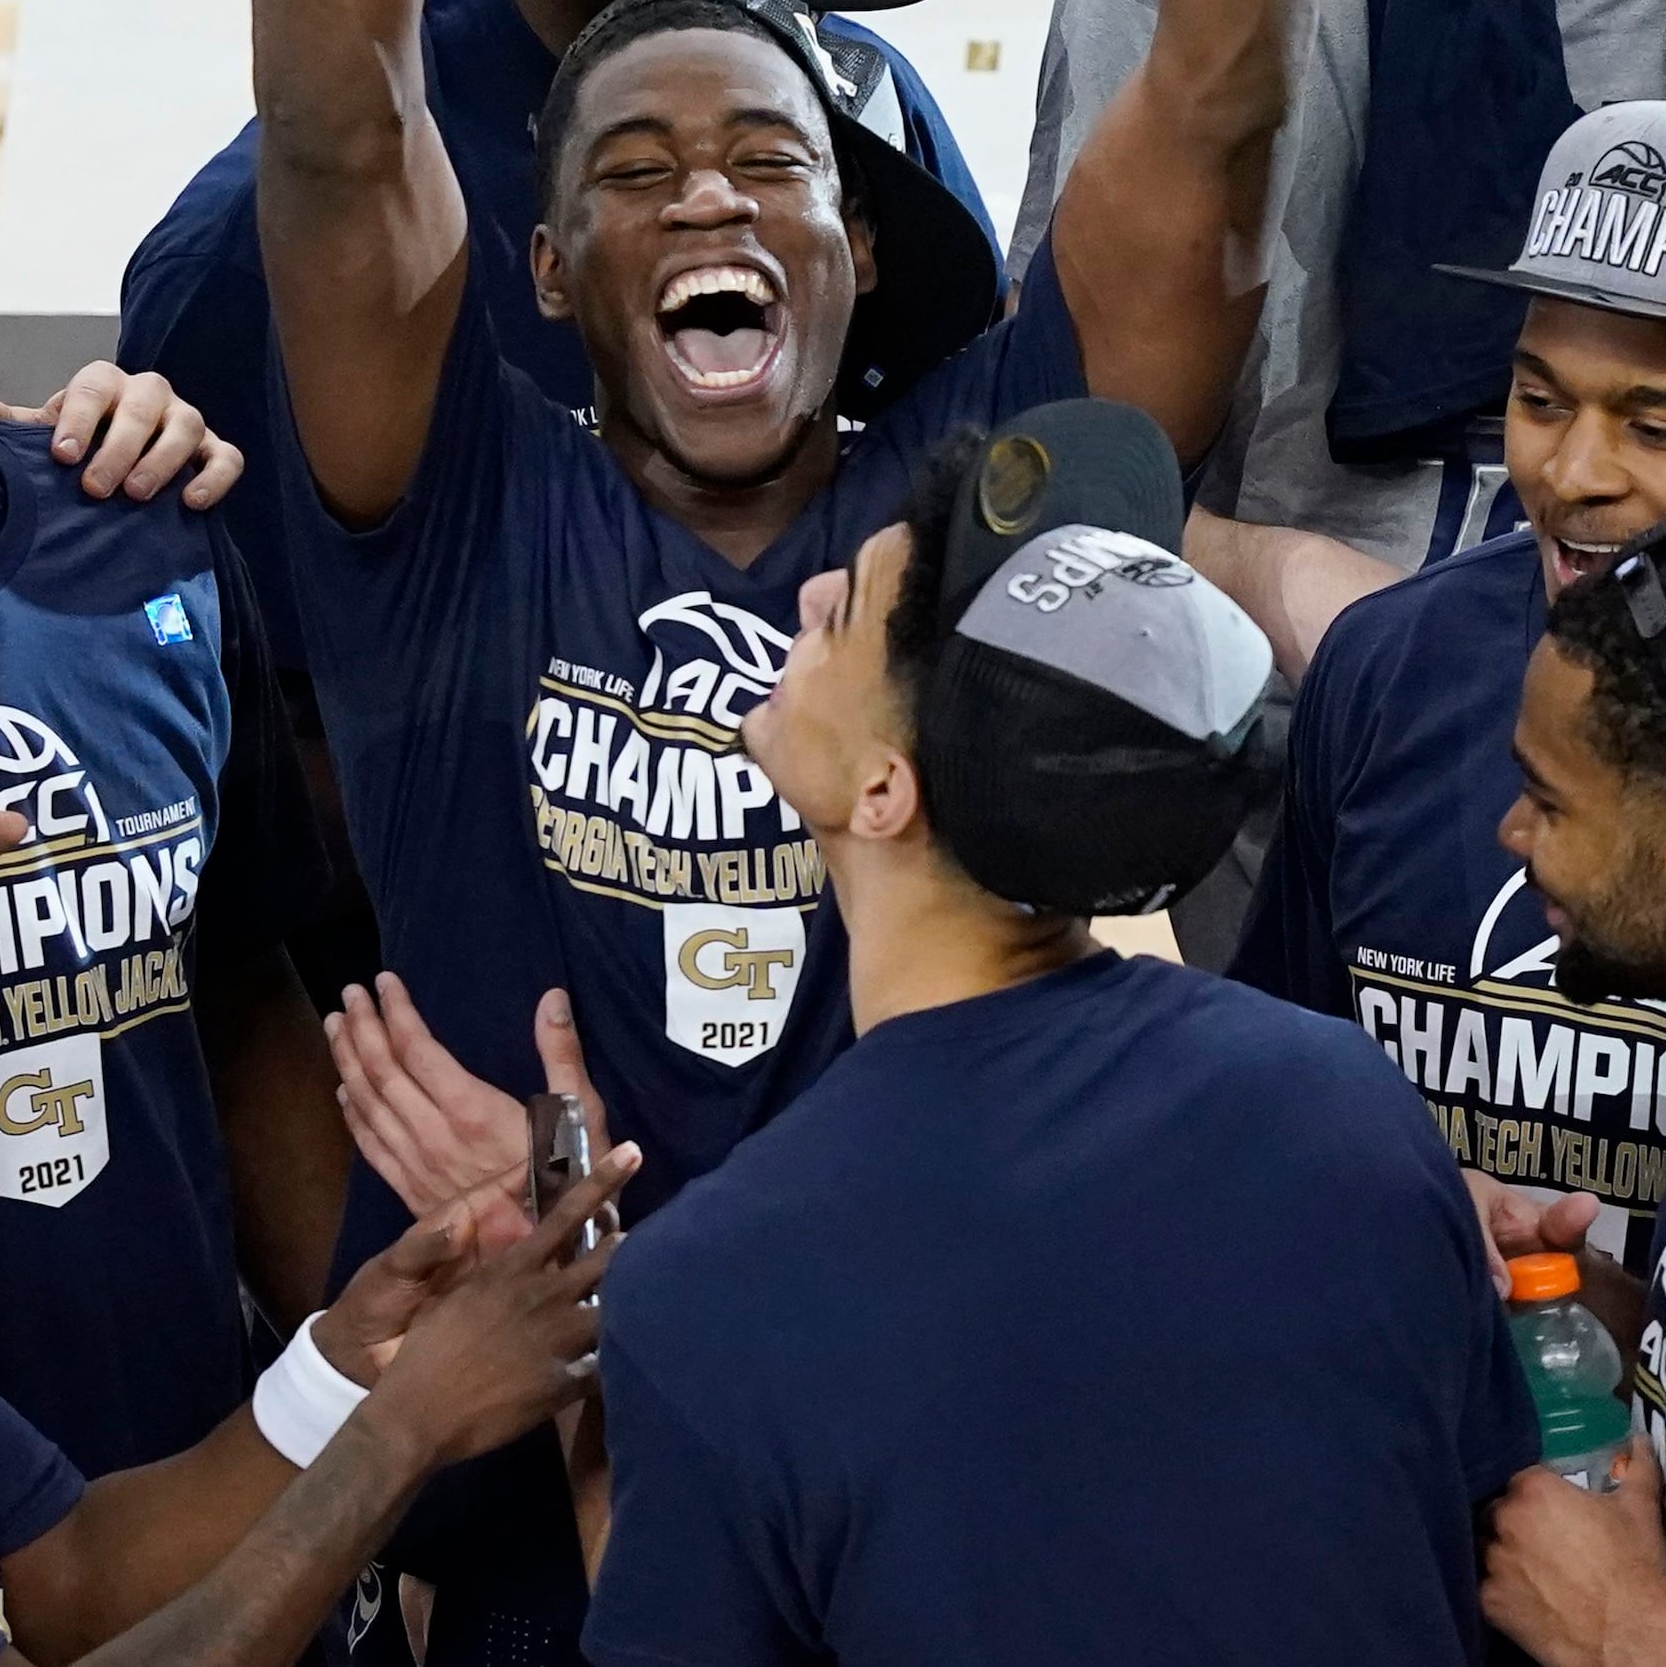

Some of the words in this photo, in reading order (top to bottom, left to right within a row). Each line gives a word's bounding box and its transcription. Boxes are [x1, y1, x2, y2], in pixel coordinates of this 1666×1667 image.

[1595, 165, 1666, 196] ACC
[571, 665, 605, 693] YORK
[605, 675, 635, 703] LIFE
[697, 838, 827, 903] YELLOW
[679, 928, 794, 1000] GT
[1357, 946, 1387, 969] NEW
[1390, 953, 1424, 977] YORK
[1427, 961, 1456, 984] LIFE
[702, 1021, 769, 1049] 2021
[1474, 1110, 1542, 1178] TECH
[19, 1154, 85, 1194] 2021
